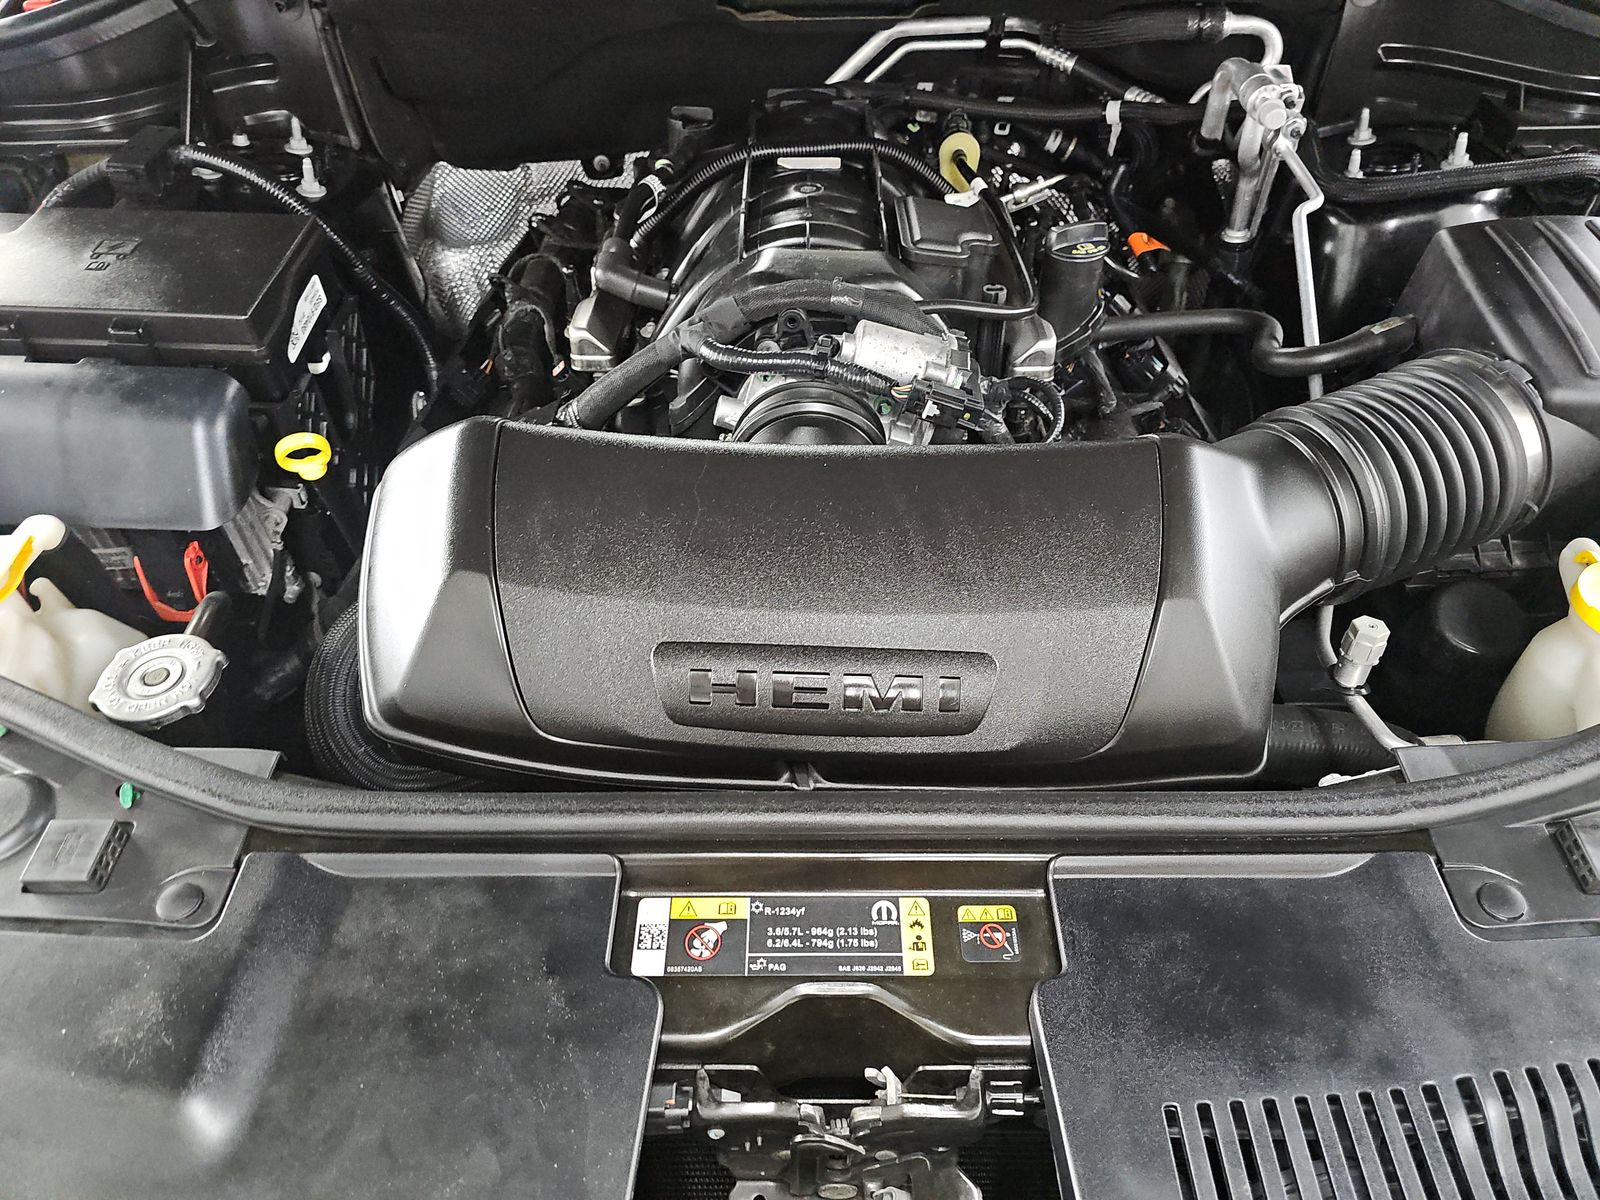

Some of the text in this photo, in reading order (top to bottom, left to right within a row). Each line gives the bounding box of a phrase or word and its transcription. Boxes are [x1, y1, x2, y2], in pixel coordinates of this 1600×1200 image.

[689, 668, 961, 712] HEMI
[764, 906, 806, 917] R-1234yf
[766, 927, 804, 936] 3.6/5.7L
[836, 927, 858, 937] (2.13
[766, 939, 804, 948] 6.2/6.4L
[811, 939, 834, 949] 794g
[768, 963, 787, 972] PAG
